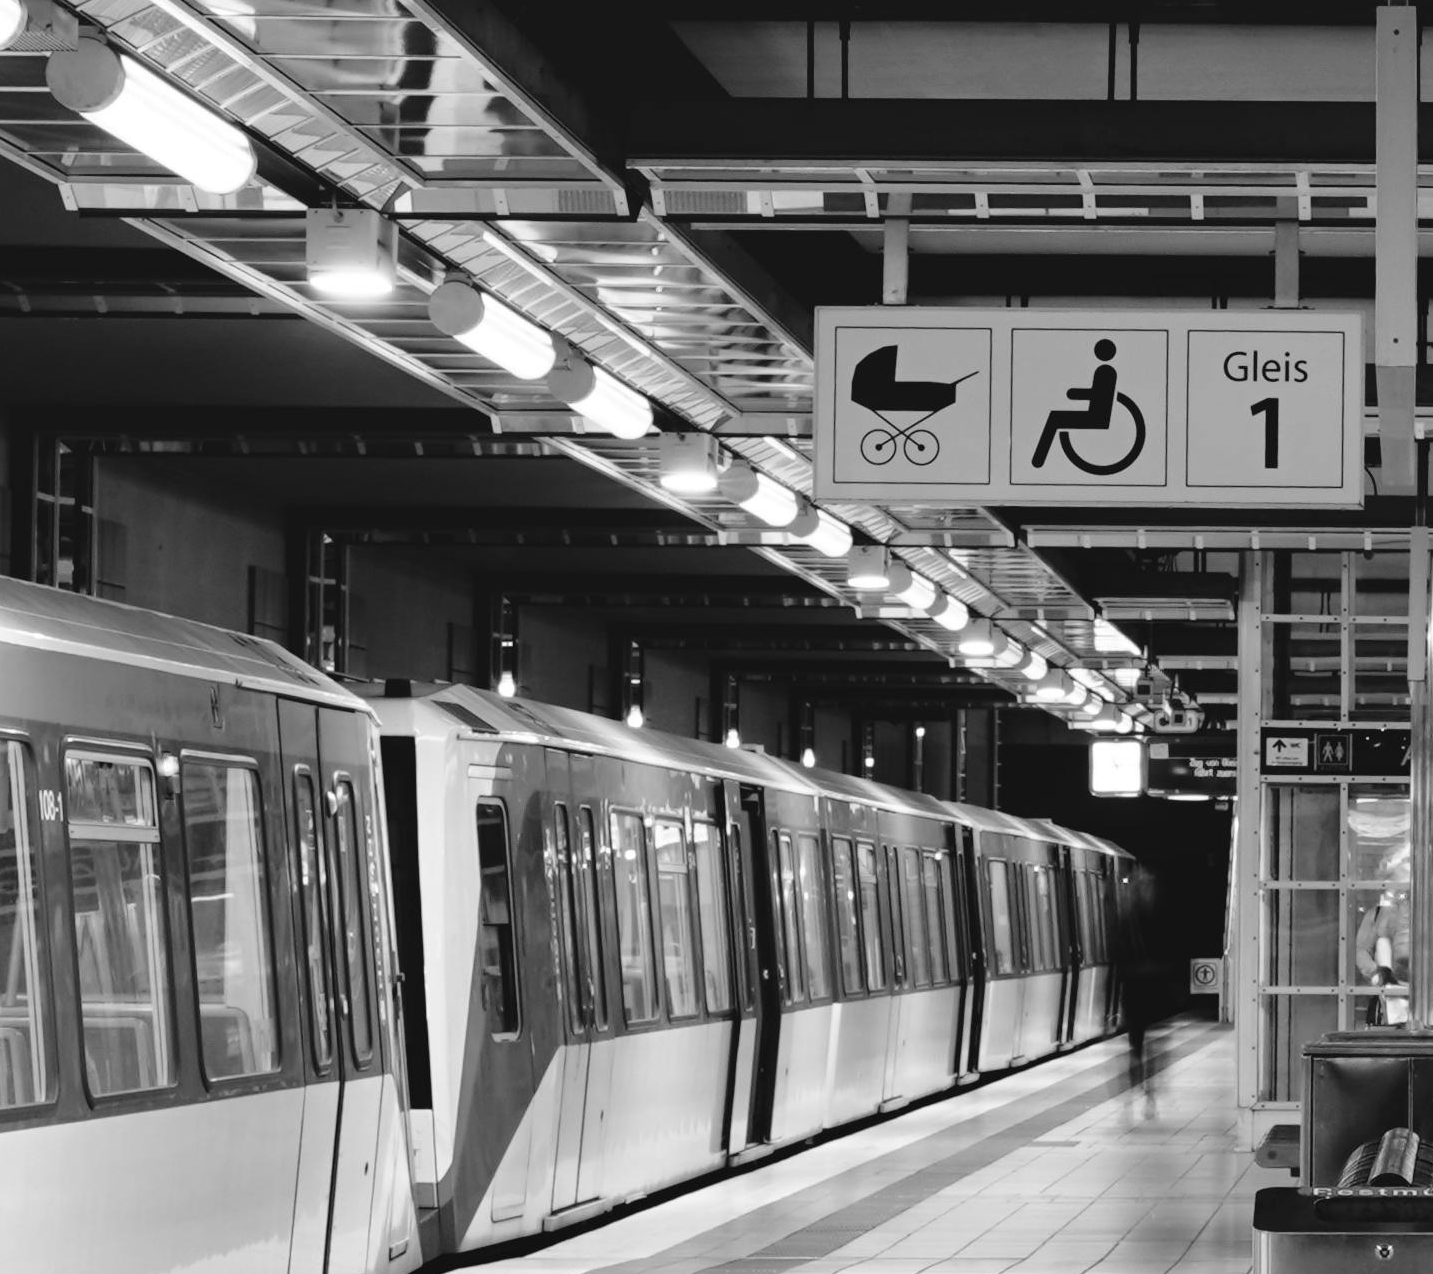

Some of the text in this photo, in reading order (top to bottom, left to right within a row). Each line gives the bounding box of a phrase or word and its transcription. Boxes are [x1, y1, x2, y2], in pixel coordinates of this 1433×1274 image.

[1223, 350, 1308, 383] Gleis
[1250, 397, 1279, 469] 1
[38, 789, 64, 822] 108-1
